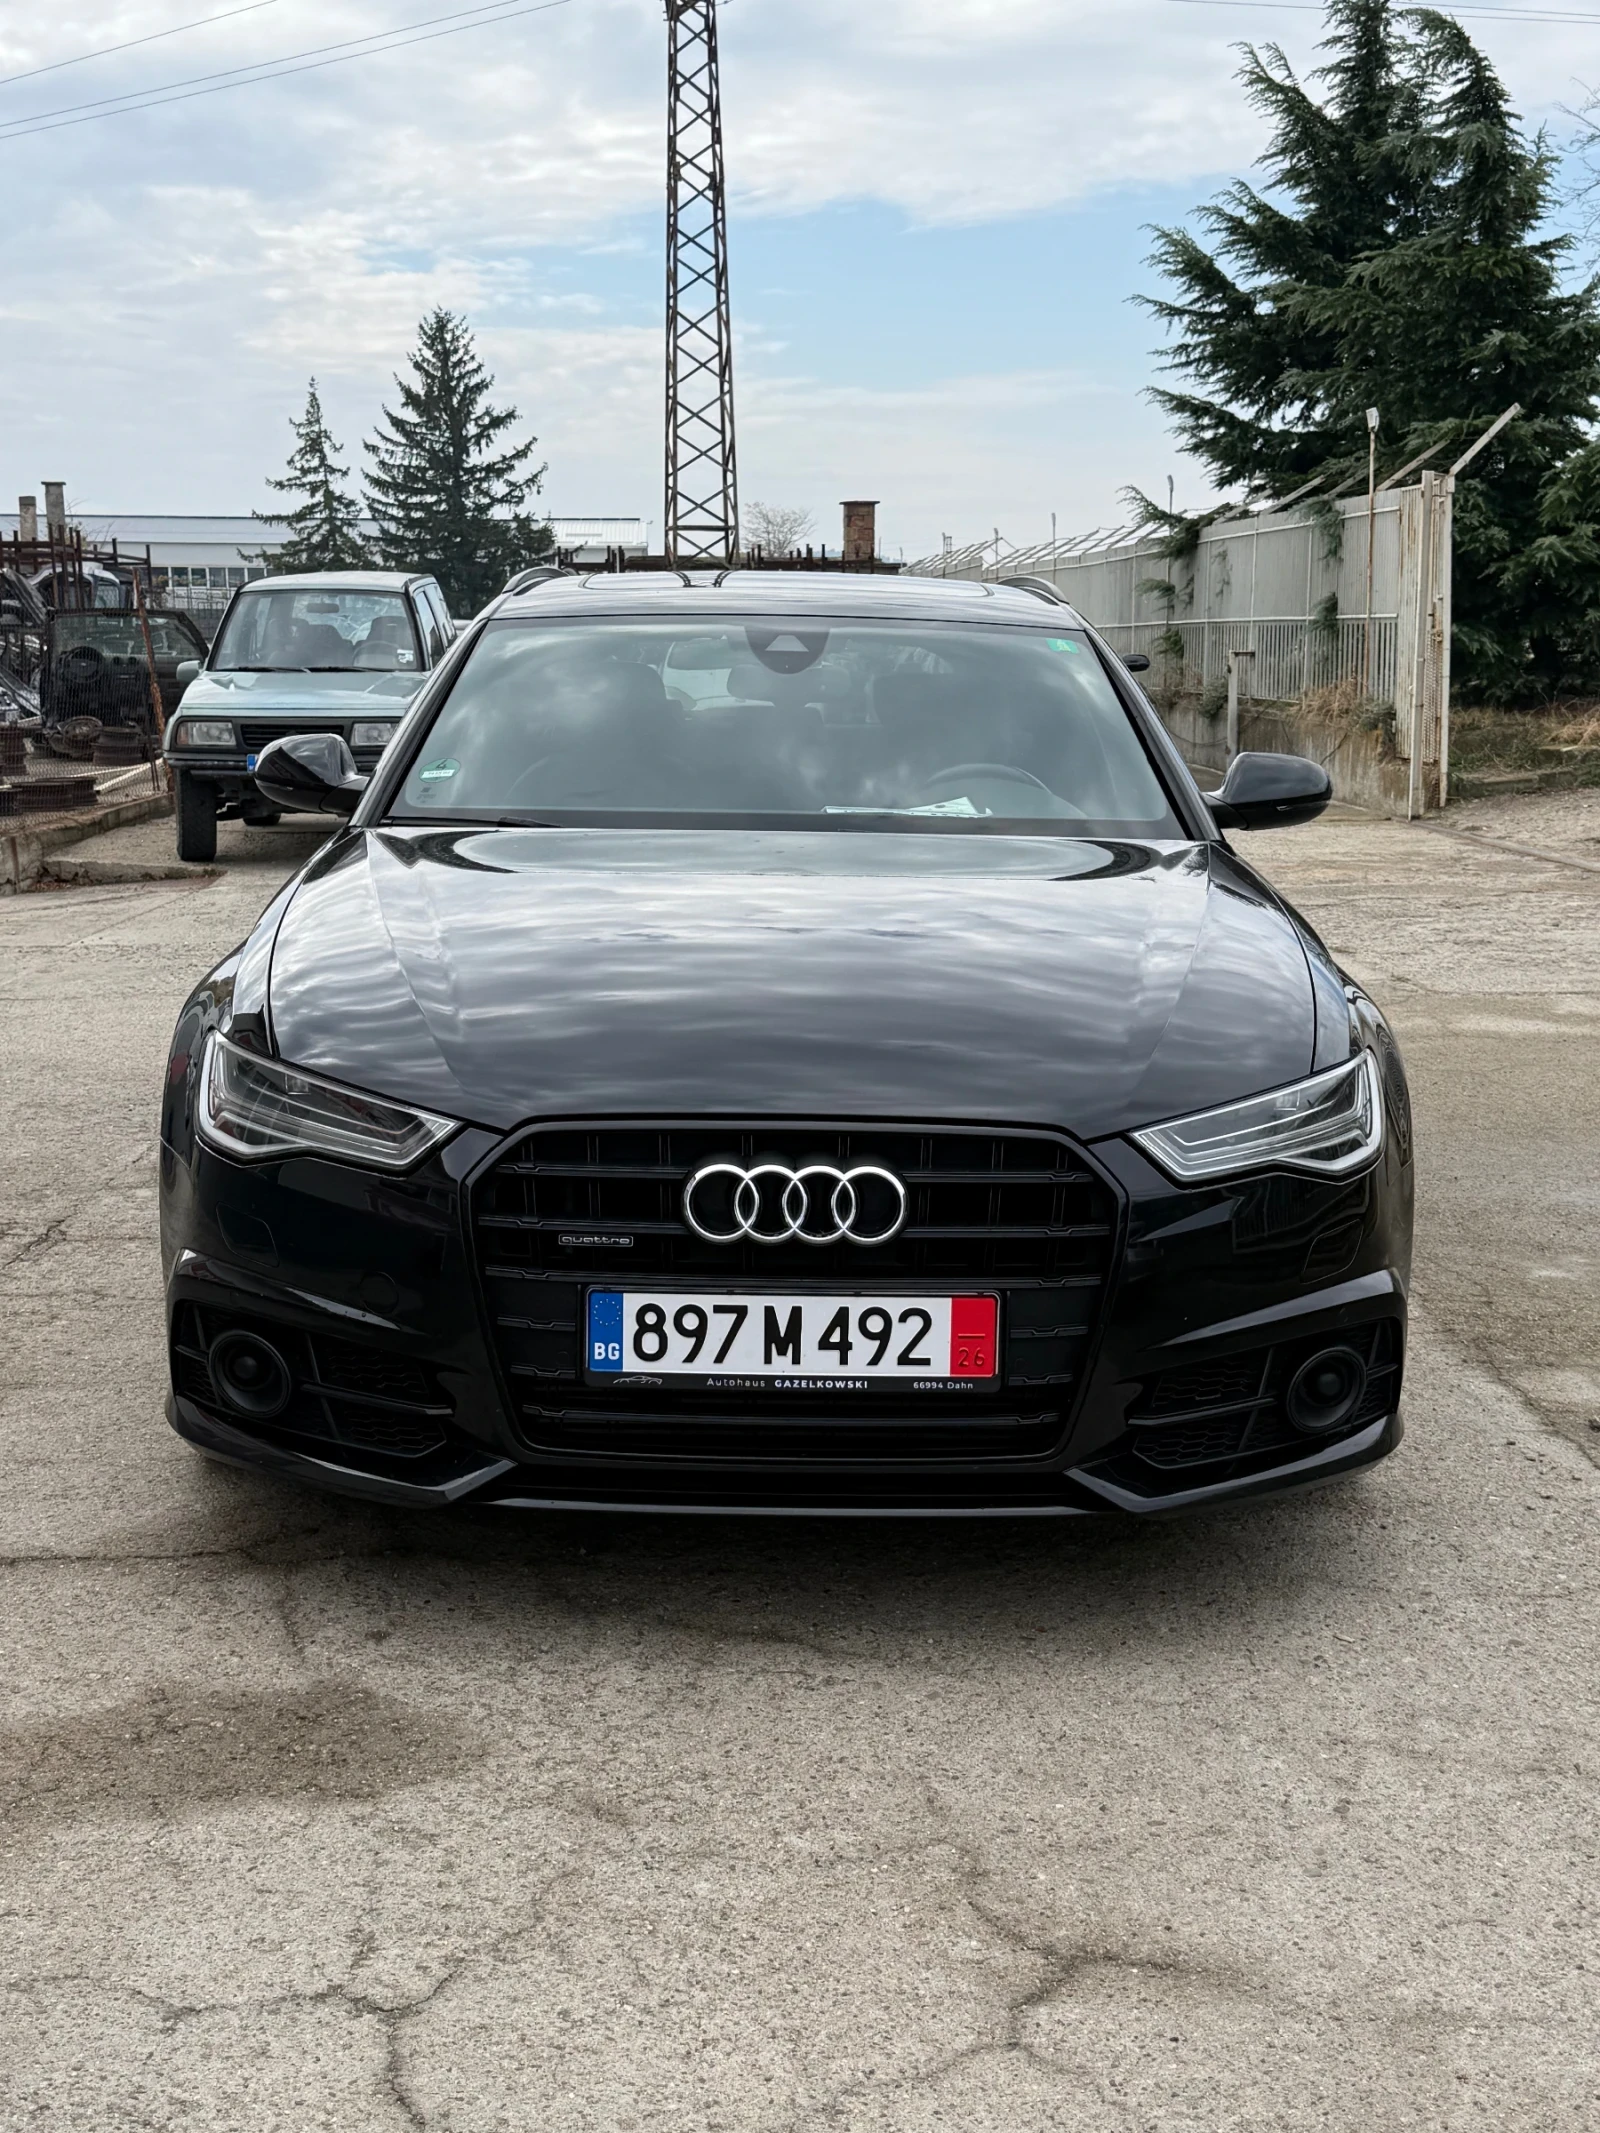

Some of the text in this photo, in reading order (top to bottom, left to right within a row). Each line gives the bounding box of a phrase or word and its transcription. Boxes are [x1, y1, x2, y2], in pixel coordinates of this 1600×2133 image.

[562, 1236, 630, 1244] quattro
[633, 1303, 932, 1366] 897 M 492
[594, 1342, 620, 1360] BG
[958, 1347, 985, 1367] 26
[707, 1377, 766, 1387] Autohaus
[774, 1380, 868, 1388] GAZELKOWSKI
